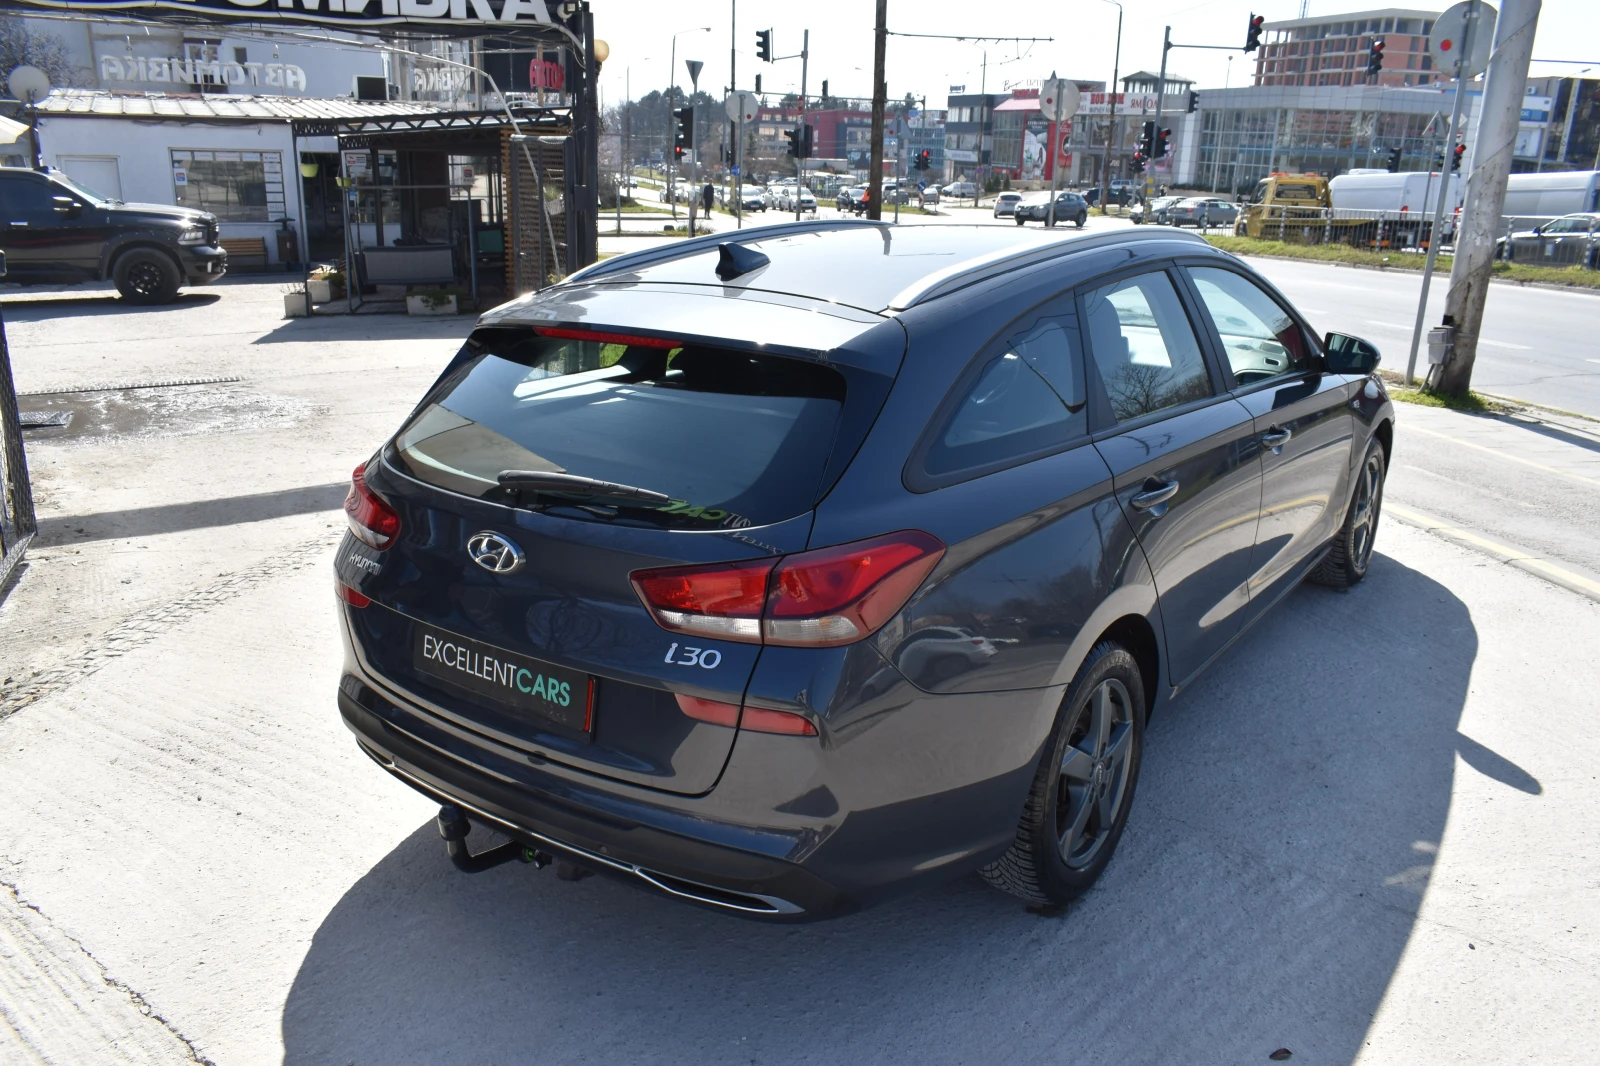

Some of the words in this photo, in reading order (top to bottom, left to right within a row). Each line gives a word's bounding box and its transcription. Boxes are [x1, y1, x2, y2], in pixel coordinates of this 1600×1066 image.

[1107, 93, 1125, 106] ДМ
[1130, 98, 1158, 109] ЯМОЛ
[664, 642, 722, 669] i30
